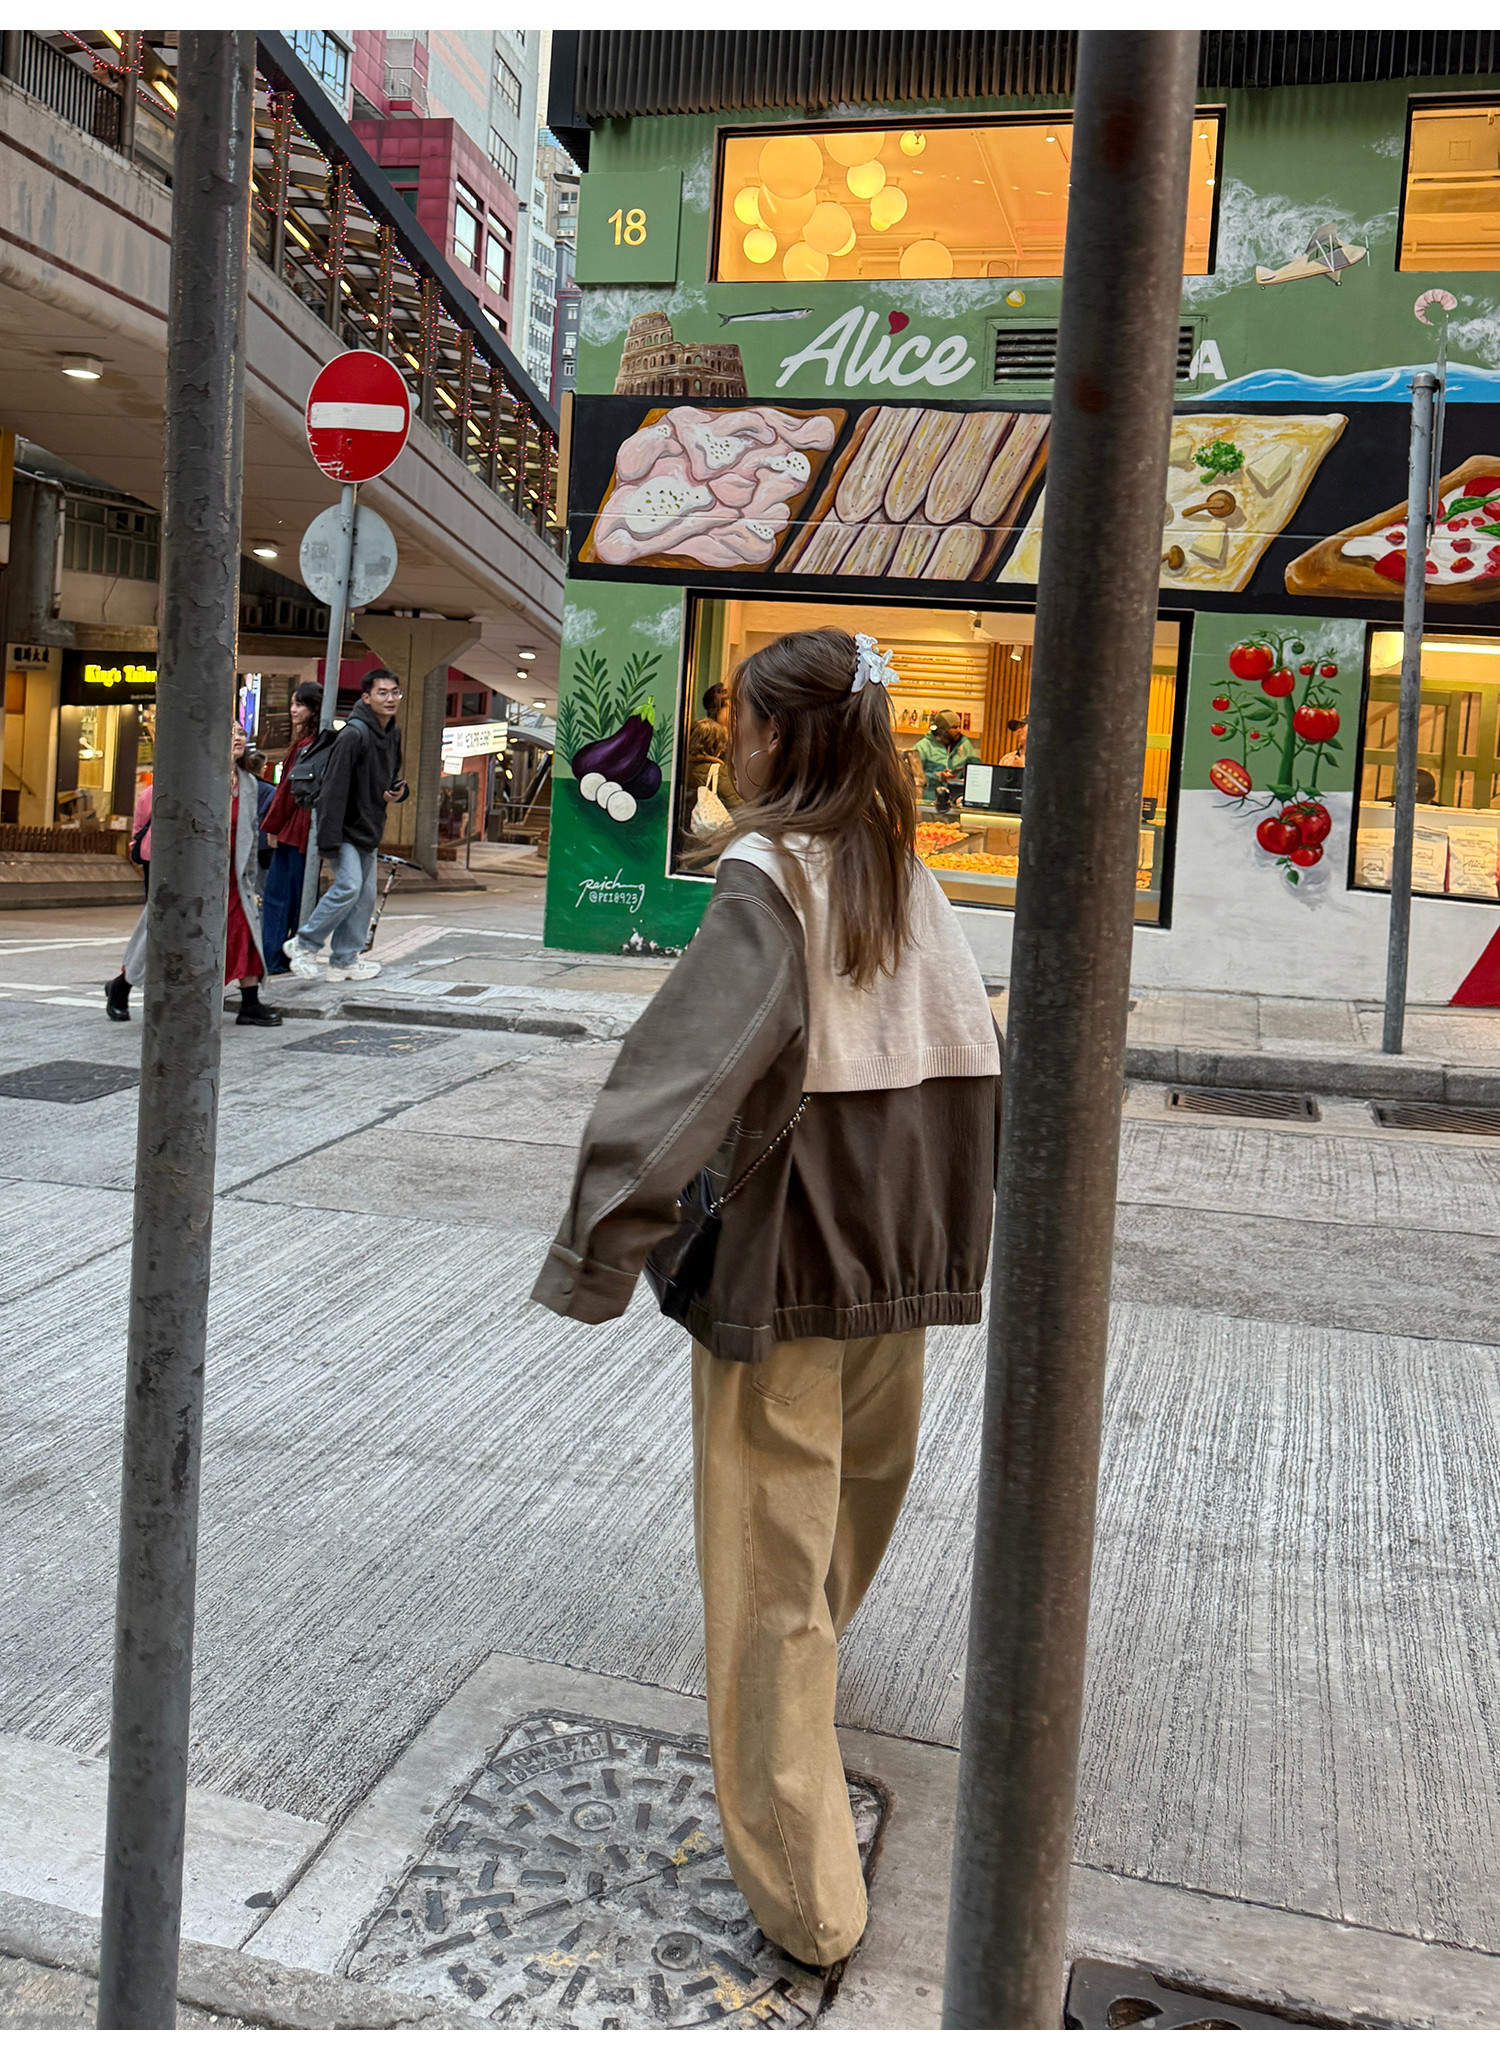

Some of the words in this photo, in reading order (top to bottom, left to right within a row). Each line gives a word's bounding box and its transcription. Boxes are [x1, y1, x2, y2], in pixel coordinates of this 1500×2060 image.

[607, 208, 647, 246] 18
[775, 305, 977, 388] Alice
[84, 664, 121, 687] King's
